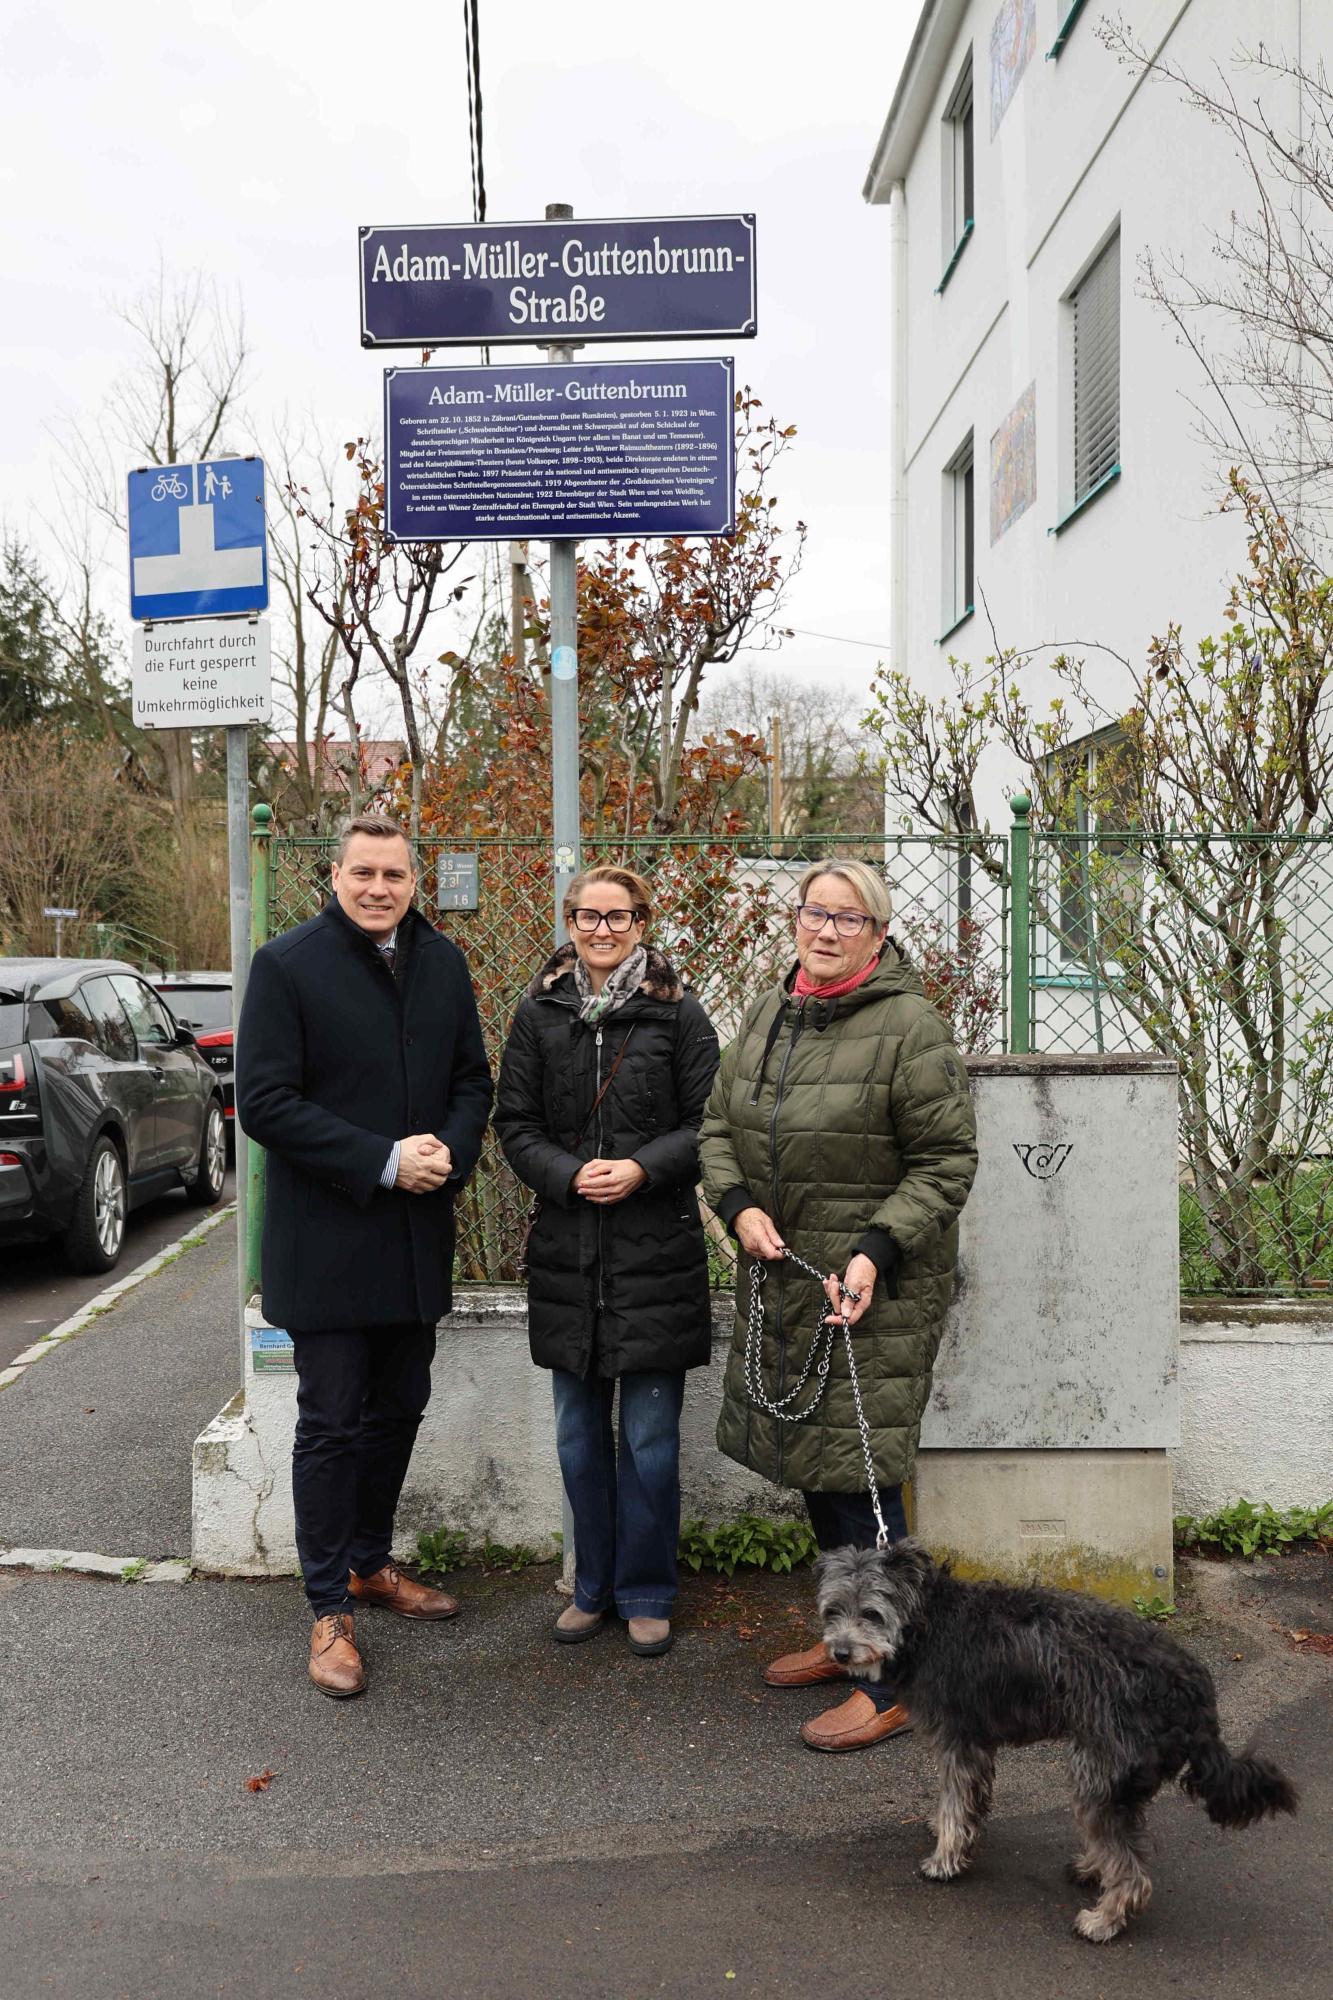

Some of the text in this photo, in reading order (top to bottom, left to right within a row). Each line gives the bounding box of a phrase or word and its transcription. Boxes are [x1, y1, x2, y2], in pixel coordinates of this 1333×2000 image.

[371, 237, 745, 283] Adam-Müller-Guttenbrunn-
[508, 284, 606, 325] Straße
[428, 379, 688, 405] Adam-Müller-Guttenbrunn
[560, 413, 581, 422] (heute
[619, 411, 652, 420] gestorben
[417, 427, 457, 435] Schriftsteller
[585, 423, 626, 432] Schwerpunkt
[411, 438, 469, 447] deutschsprachigen
[516, 435, 551, 444] Königreich
[552, 435, 576, 444] Ungarn
[578, 434, 591, 443] (vor
[400, 450, 425, 459] Mitglied
[438, 448, 485, 458] Freimaurerloge
[619, 443, 673, 451] Raimundtheaters
[425, 459, 504, 469] Kaiserjubiläums-Theaters
[505, 458, 525, 467] (heute
[625, 455, 661, 463] Direktorate
[407, 471, 456, 479] wirtschaftlichen
[501, 469, 531, 477] Präsident
[641, 466, 680, 475] eingestuften
[400, 482, 452, 490] Österreichischen
[454, 480, 543, 490] Schriftstellergenossenschaft.
[564, 479, 608, 488] Abgeordneter
[443, 492, 494, 500] österreichischen
[556, 490, 595, 499] Ehrenbürger
[532, 502, 565, 511] Ehrengrab
[634, 500, 680, 509] umfangreiches
[497, 513, 550, 521] deutschnationale
[145, 634, 256, 652] Durchfahrt durch
[145, 655, 257, 673] die Furt gesperrt
[183, 676, 218, 691] keine
[137, 694, 265, 713] Umkehrmöglichkeit
[9, 1100, 27, 1111] i3
